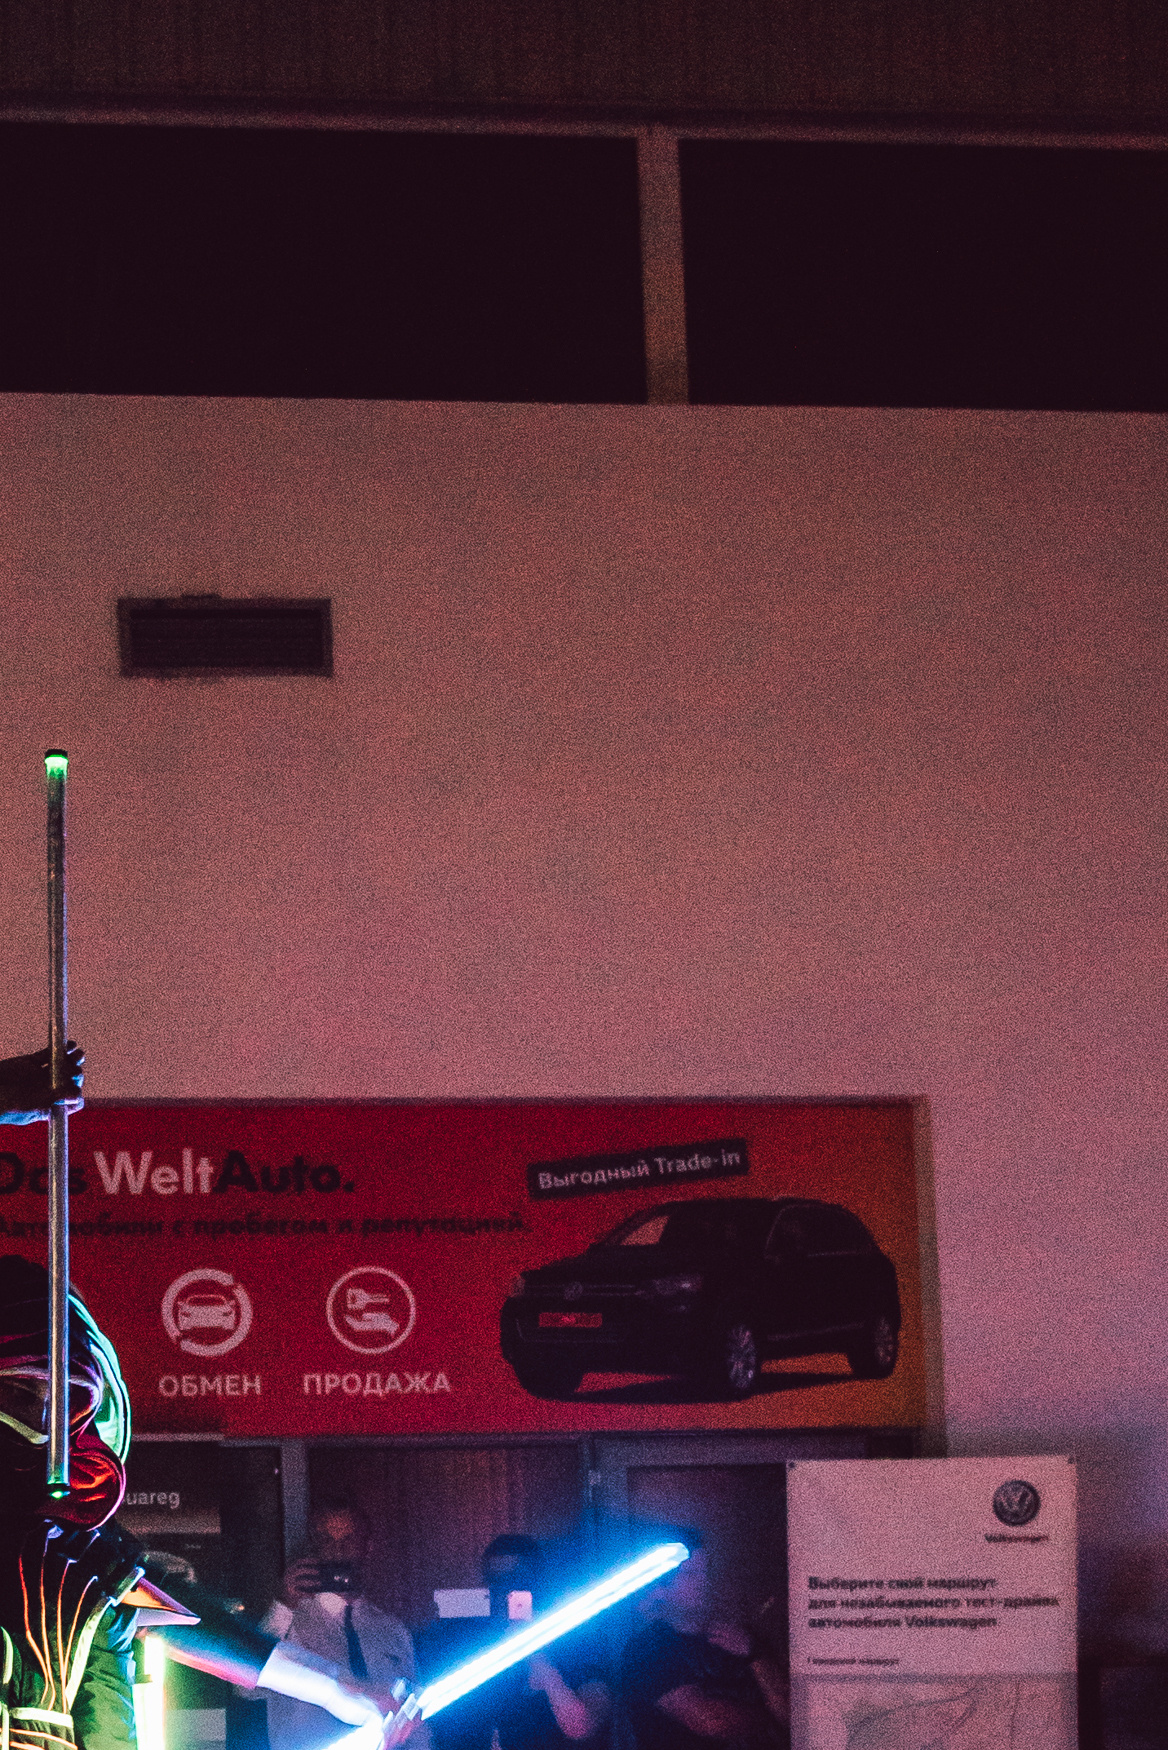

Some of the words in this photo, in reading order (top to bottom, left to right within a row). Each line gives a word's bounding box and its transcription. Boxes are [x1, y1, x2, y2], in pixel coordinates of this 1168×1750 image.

[537, 1158, 650, 1190] Выгодный
[654, 1149, 741, 1175] Trade-in
[158, 1373, 262, 1398] ОБМЕН
[302, 1371, 451, 1399] ПРОДАЖА
[125, 1491, 182, 1511] uareg
[808, 1576, 883, 1591] Выберите
[888, 1576, 924, 1590] свой
[928, 1579, 997, 1591] маршрут
[808, 1598, 836, 1611] для
[905, 1616, 998, 1630] Volkswagen
